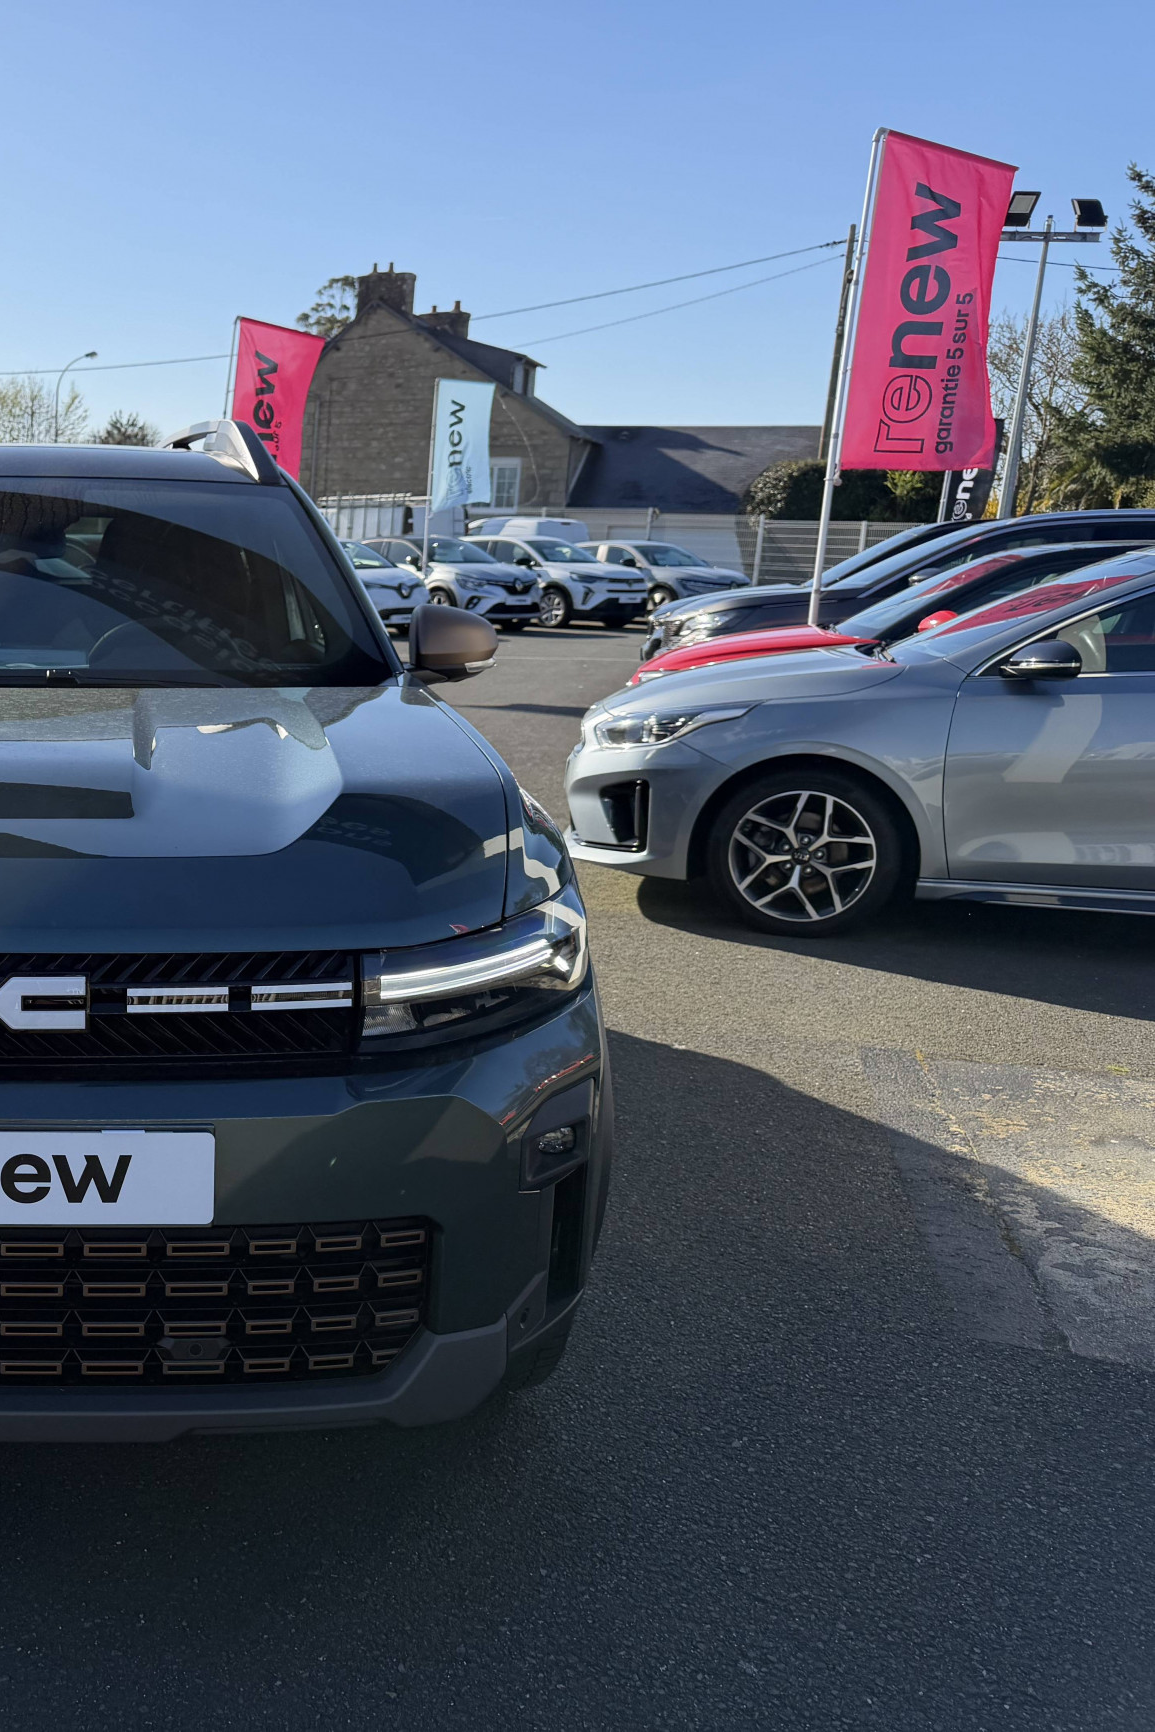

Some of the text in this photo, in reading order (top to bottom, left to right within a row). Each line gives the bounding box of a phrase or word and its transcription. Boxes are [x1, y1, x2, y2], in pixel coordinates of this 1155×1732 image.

[874, 181, 961, 453] renew
[935, 292, 974, 454] garantie 5 sur 5
